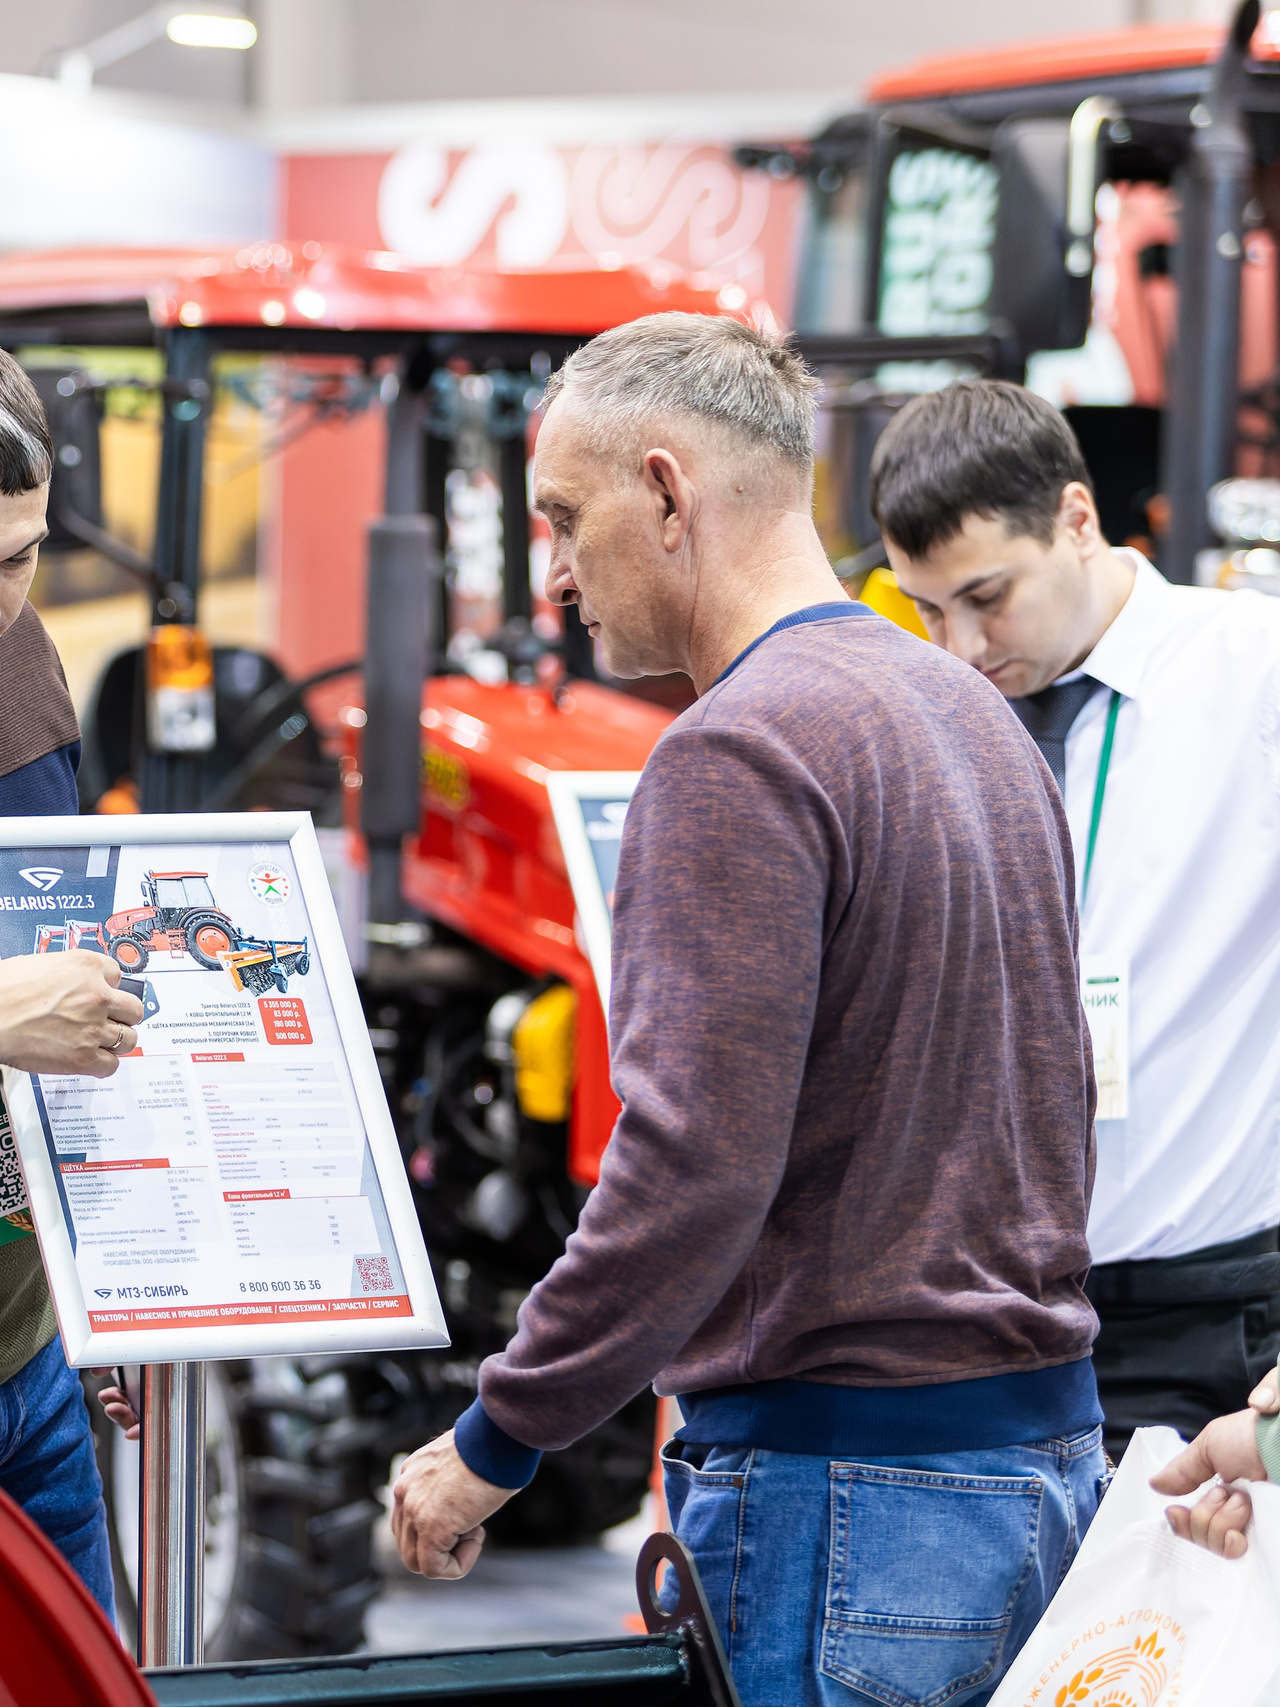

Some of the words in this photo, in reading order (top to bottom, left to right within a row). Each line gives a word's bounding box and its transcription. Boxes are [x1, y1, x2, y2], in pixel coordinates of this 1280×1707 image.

[56, 894, 95, 908] 1222.3
[1084, 993, 1119, 1008] НИК
[63, 1164, 83, 1172] ЩЁТКА
[241, 1192, 273, 1200] фронтальный
[117, 1285, 188, 1299] МТЗ-СИБИРЬ
[239, 1282, 246, 1292] 8
[249, 1281, 269, 1292] 800
[271, 1280, 291, 1291] 600
[293, 1280, 306, 1291] 36
[308, 1279, 321, 1290] 36
[92, 1313, 129, 1322] ТРАКТОРЫ
[135, 1310, 171, 1321] НАВЕСНОЕ
[178, 1308, 219, 1319] ПРИЦЕПНОЕ
[220, 1305, 273, 1316] ОБОРУДОВАНИЕ
[279, 1303, 327, 1314] СПЕЦТЕХНИКА
[332, 1300, 367, 1311] ЗАПЧАСТИ
[372, 1299, 400, 1309] СЕРВИС
